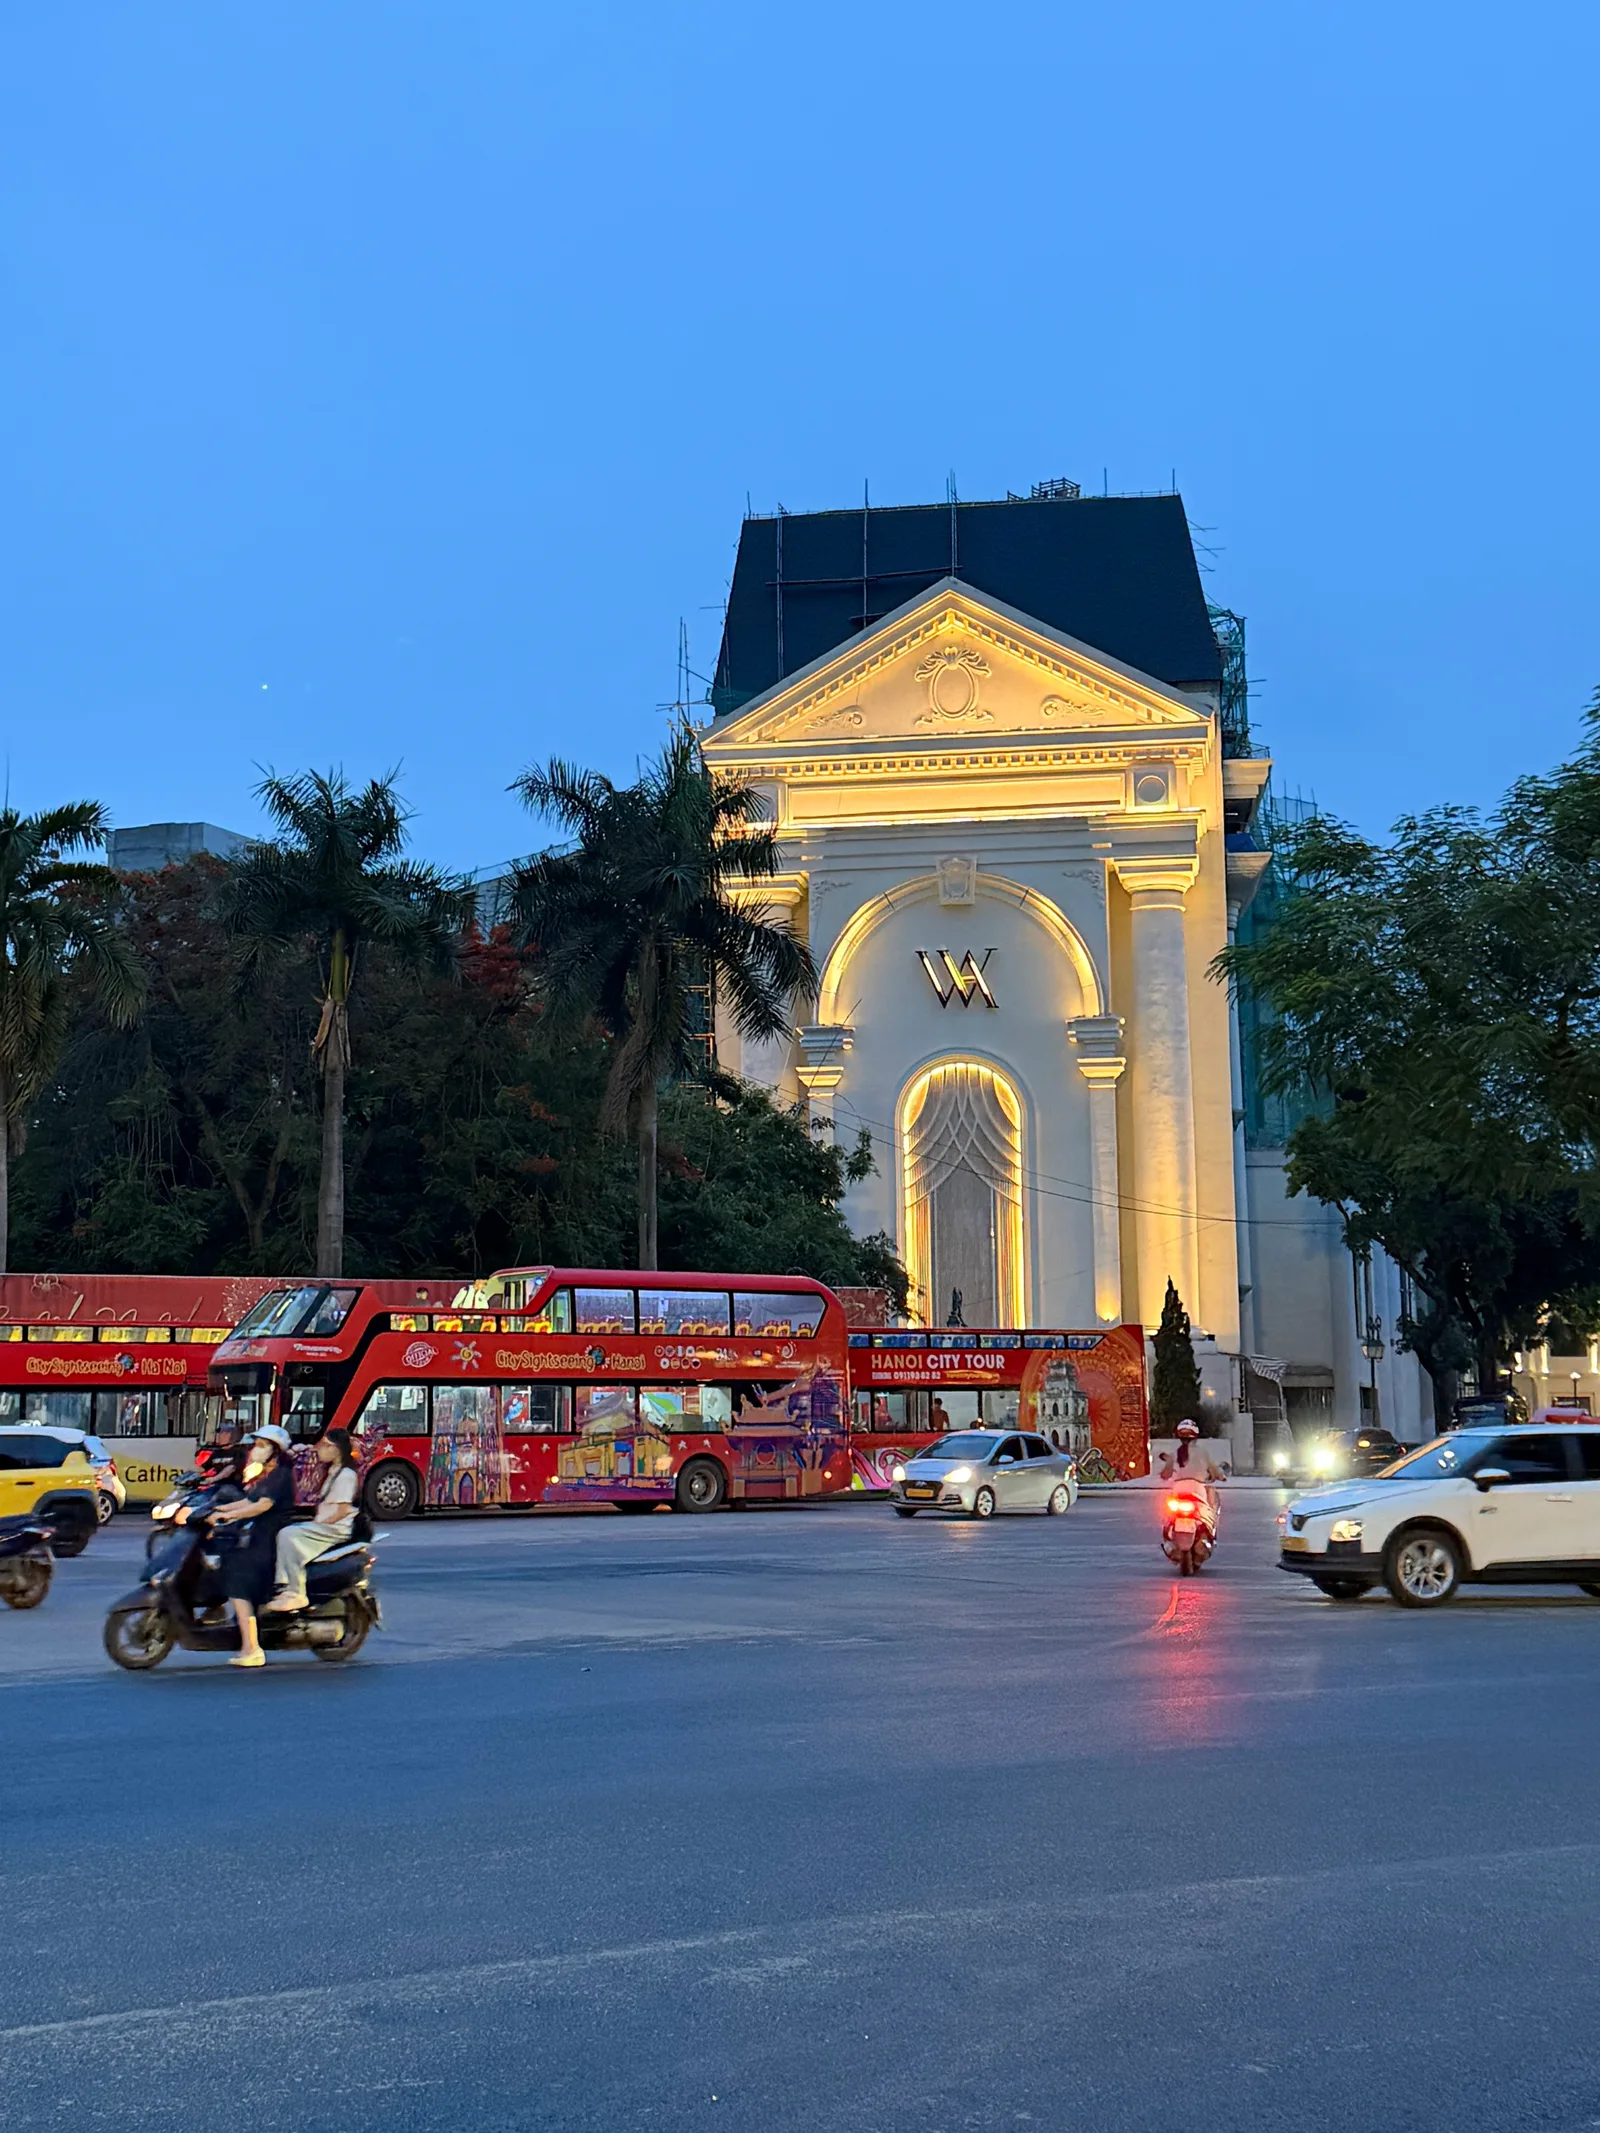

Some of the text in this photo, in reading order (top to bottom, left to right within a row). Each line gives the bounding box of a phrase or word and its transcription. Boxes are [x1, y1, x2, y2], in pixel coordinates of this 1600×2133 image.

[611, 1353, 646, 1370] Hanoi
[872, 1354, 1006, 1369] HANOI CITY TOUR
